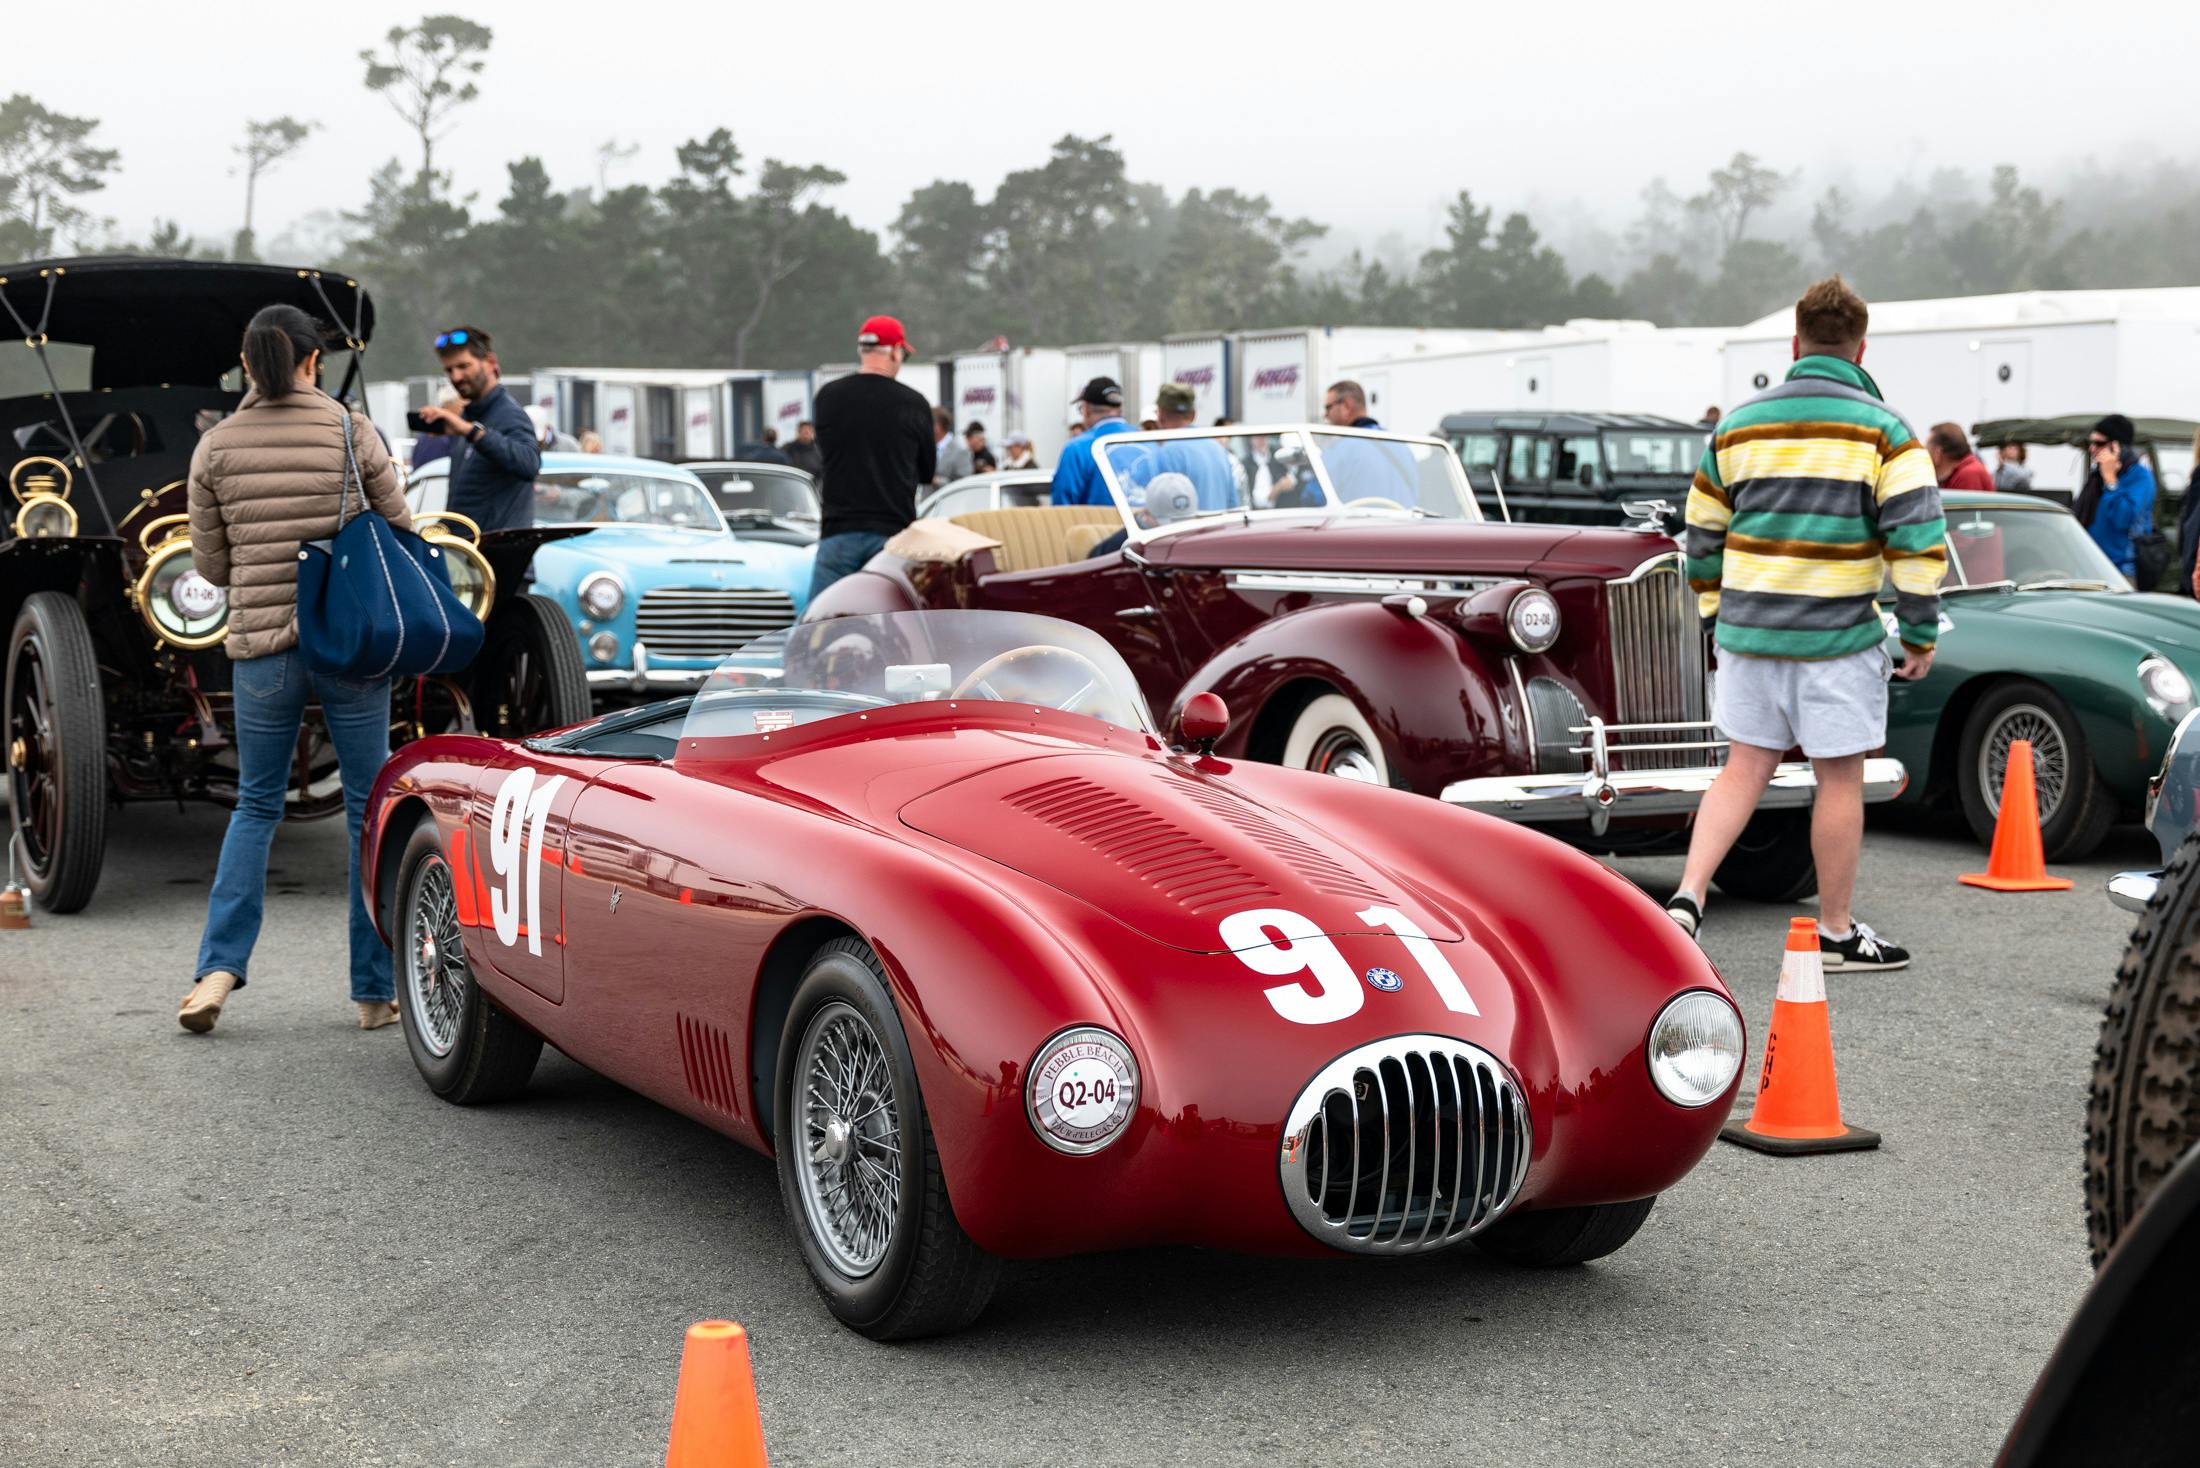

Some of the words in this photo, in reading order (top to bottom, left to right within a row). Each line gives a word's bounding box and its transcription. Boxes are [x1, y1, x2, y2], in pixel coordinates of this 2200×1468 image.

[490, 766, 568, 957] 91
[1218, 905, 1481, 1025] 91
[1044, 1046, 1084, 1080] PEBBLE
[1087, 1045, 1123, 1073] BEACH
[1760, 1032, 1777, 1095] CHP
[1059, 1078, 1116, 1110] Q2-04
[1051, 1119, 1072, 1138] TOUR
